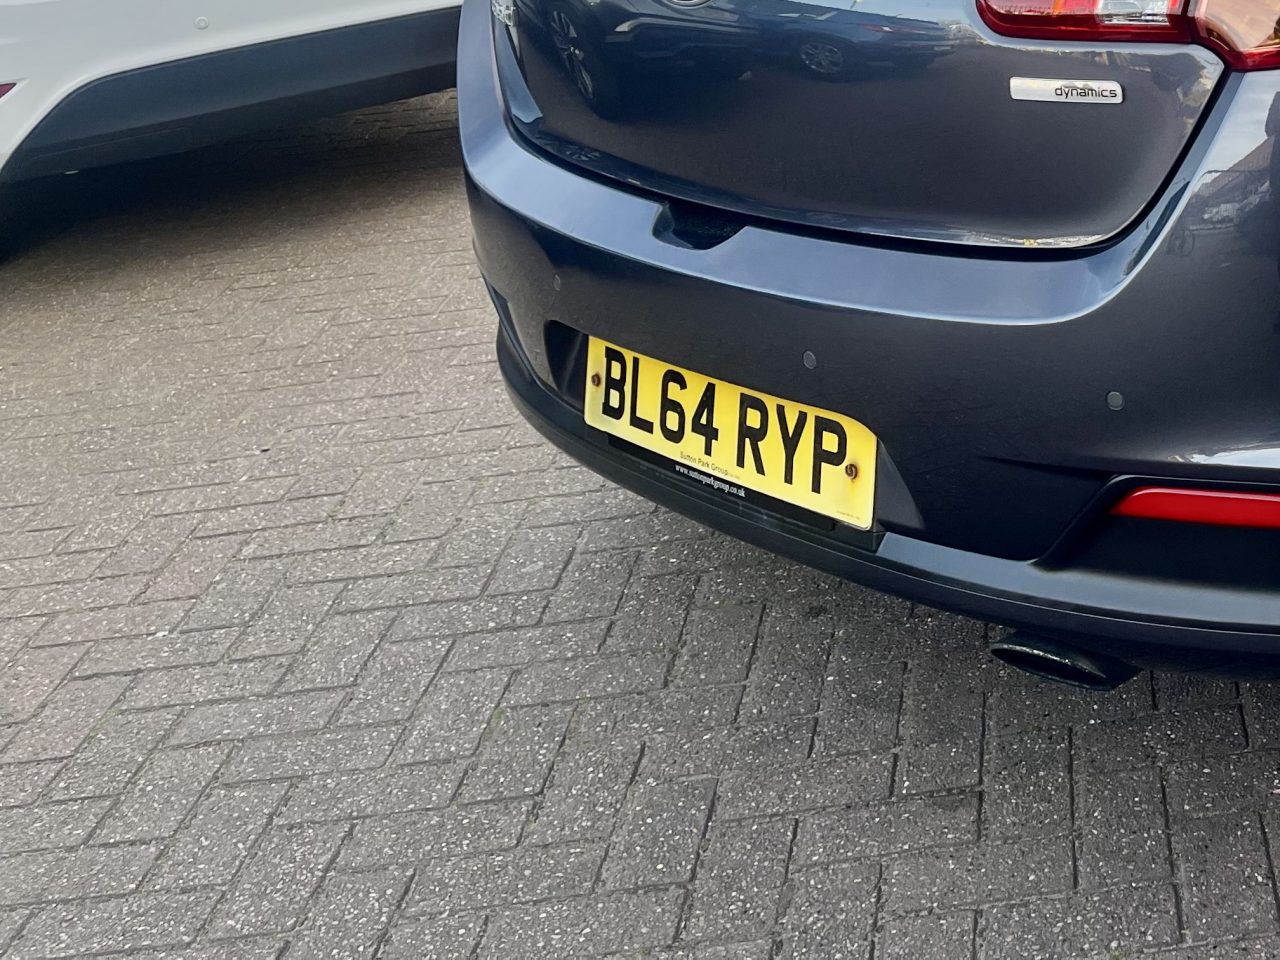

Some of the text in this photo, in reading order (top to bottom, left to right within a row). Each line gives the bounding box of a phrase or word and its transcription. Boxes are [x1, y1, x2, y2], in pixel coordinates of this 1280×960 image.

[1054, 85, 1118, 100] dynamics
[601, 345, 848, 494] BL64 RYP
[697, 457, 710, 469] Park
